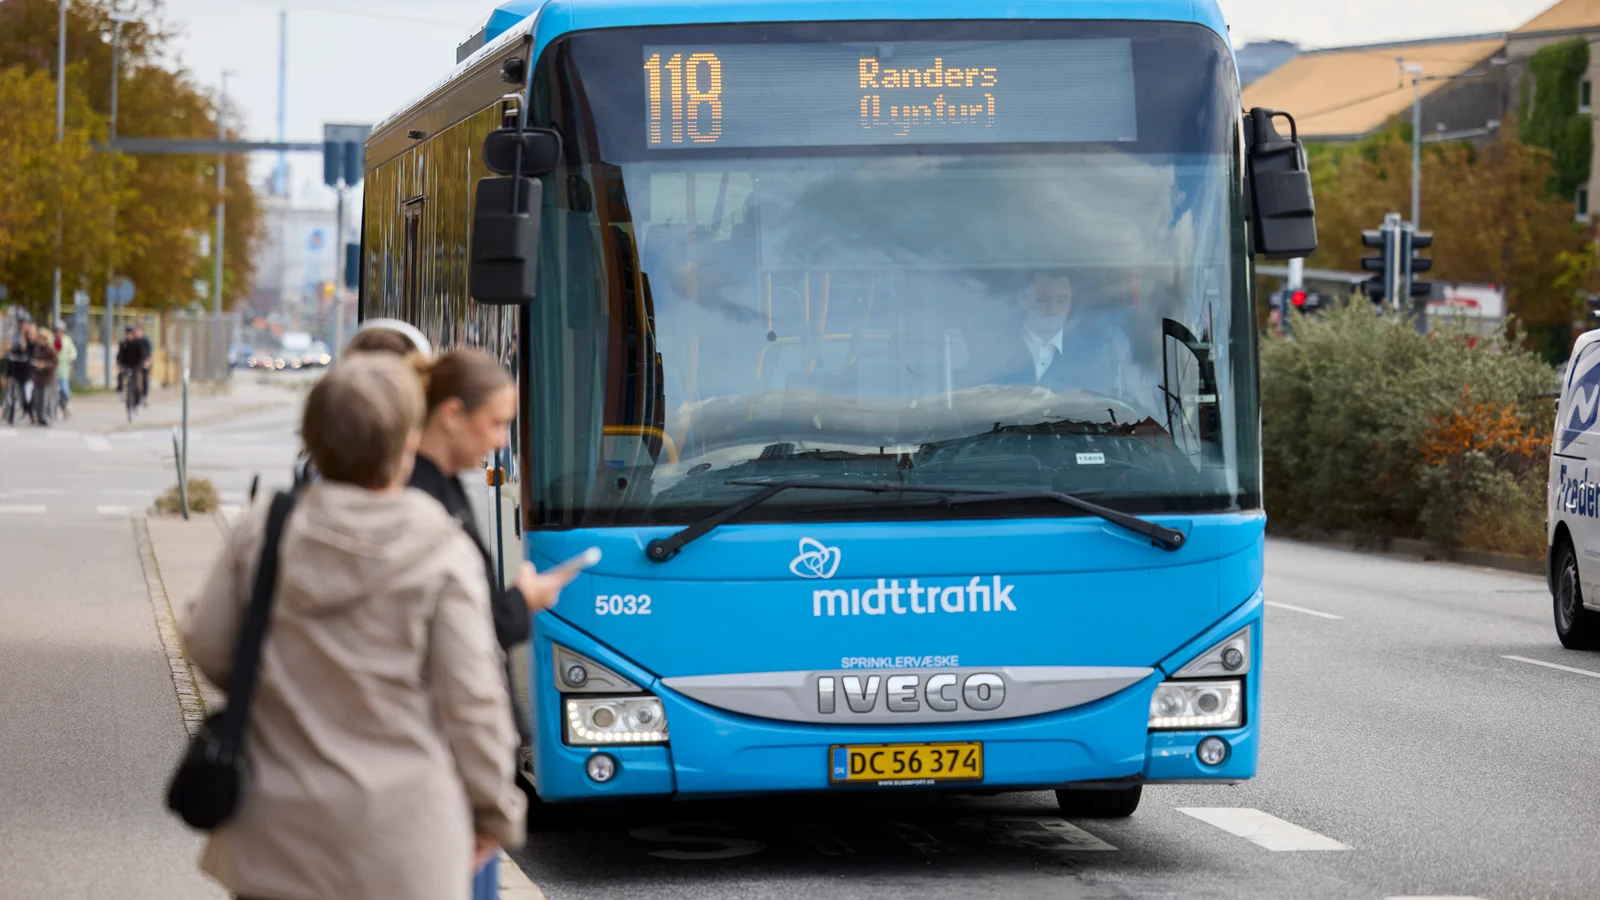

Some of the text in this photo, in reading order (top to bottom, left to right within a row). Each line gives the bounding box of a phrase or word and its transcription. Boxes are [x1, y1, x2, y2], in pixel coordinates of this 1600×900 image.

[859, 57, 997, 88] Randers
[644, 53, 721, 143] 118
[595, 594, 652, 616] 5032
[812, 575, 1017, 617] midttrafik
[841, 654, 960, 669] SPRINKLERVÆSKE
[817, 672, 1006, 714] IVECO
[851, 749, 976, 775] DC 56 374
